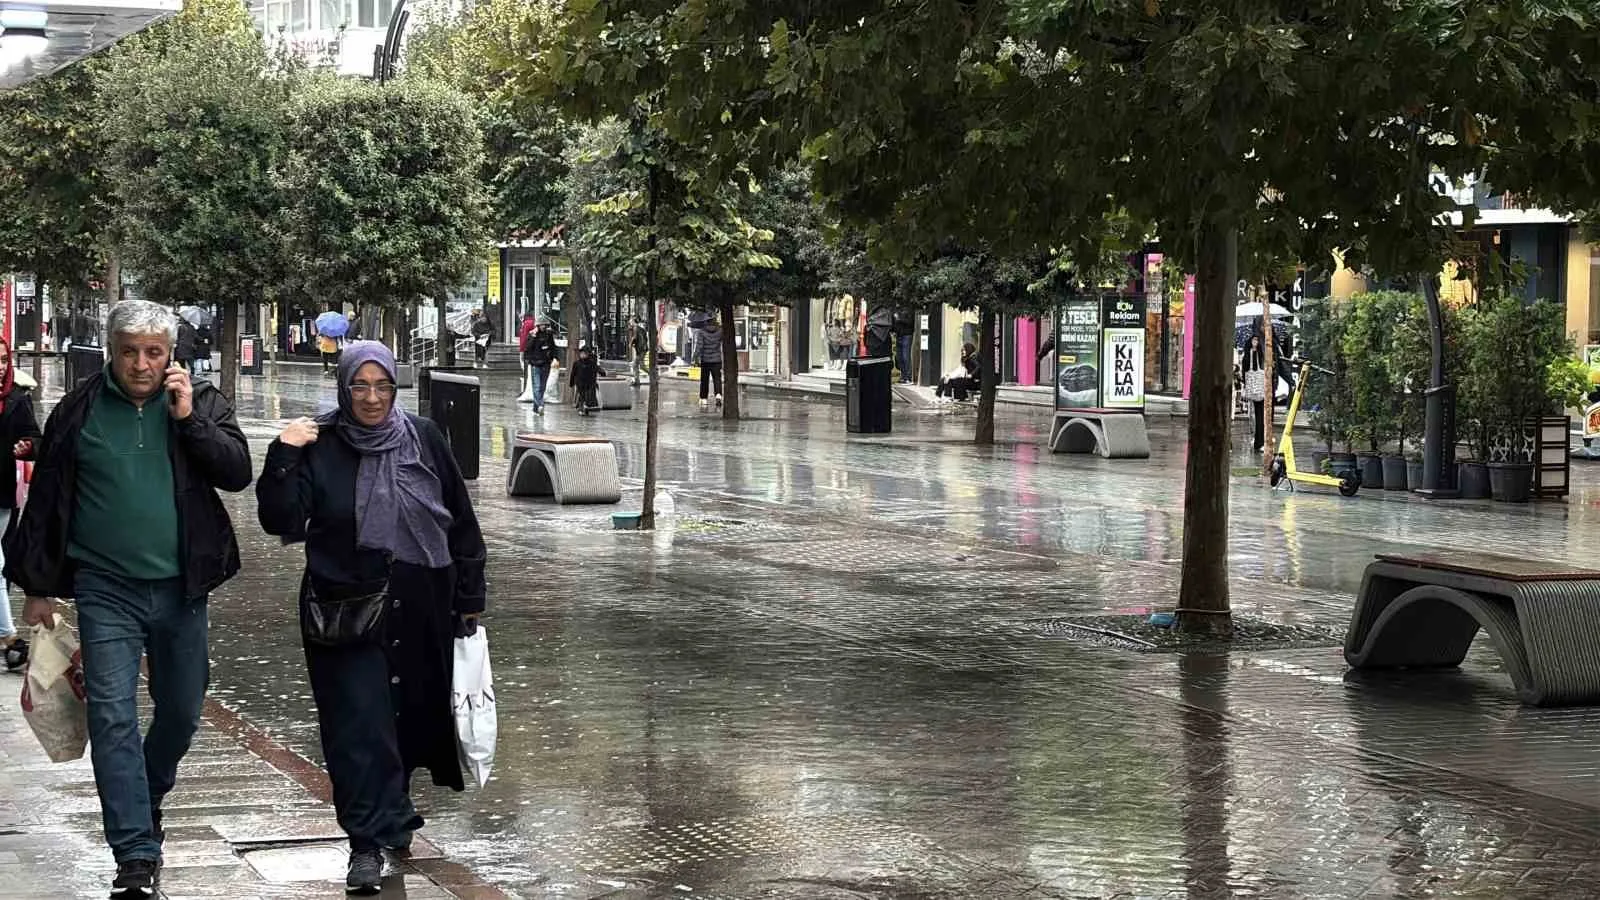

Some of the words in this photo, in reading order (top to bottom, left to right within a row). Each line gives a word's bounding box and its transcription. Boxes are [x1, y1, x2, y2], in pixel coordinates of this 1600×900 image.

[1068, 311, 1098, 325] TESLA
[1110, 311, 1140, 320] Reklam
[1115, 360, 1134, 371] RA
[1115, 372, 1134, 385] LA
[1115, 386, 1134, 396] MA
